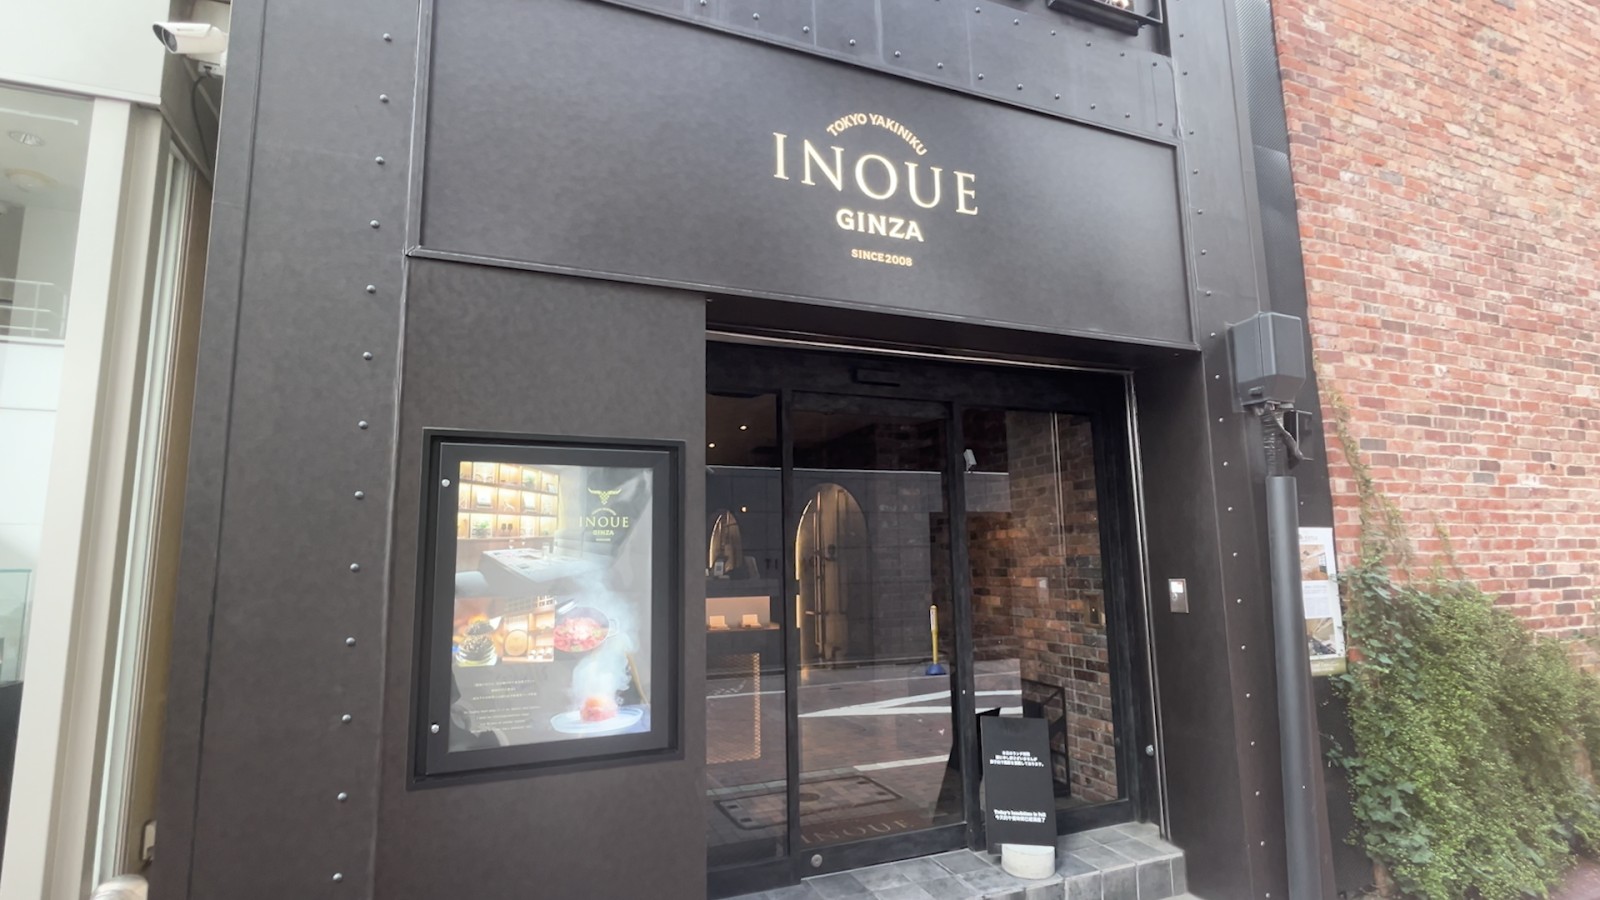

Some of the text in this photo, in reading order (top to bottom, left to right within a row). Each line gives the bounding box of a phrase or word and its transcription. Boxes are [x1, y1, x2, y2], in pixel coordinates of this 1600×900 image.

[826, 113, 928, 156] TOKYO YAKINIKU
[772, 131, 979, 216] INOUE
[835, 208, 925, 242] GINZA
[579, 516, 630, 528] INOUE
